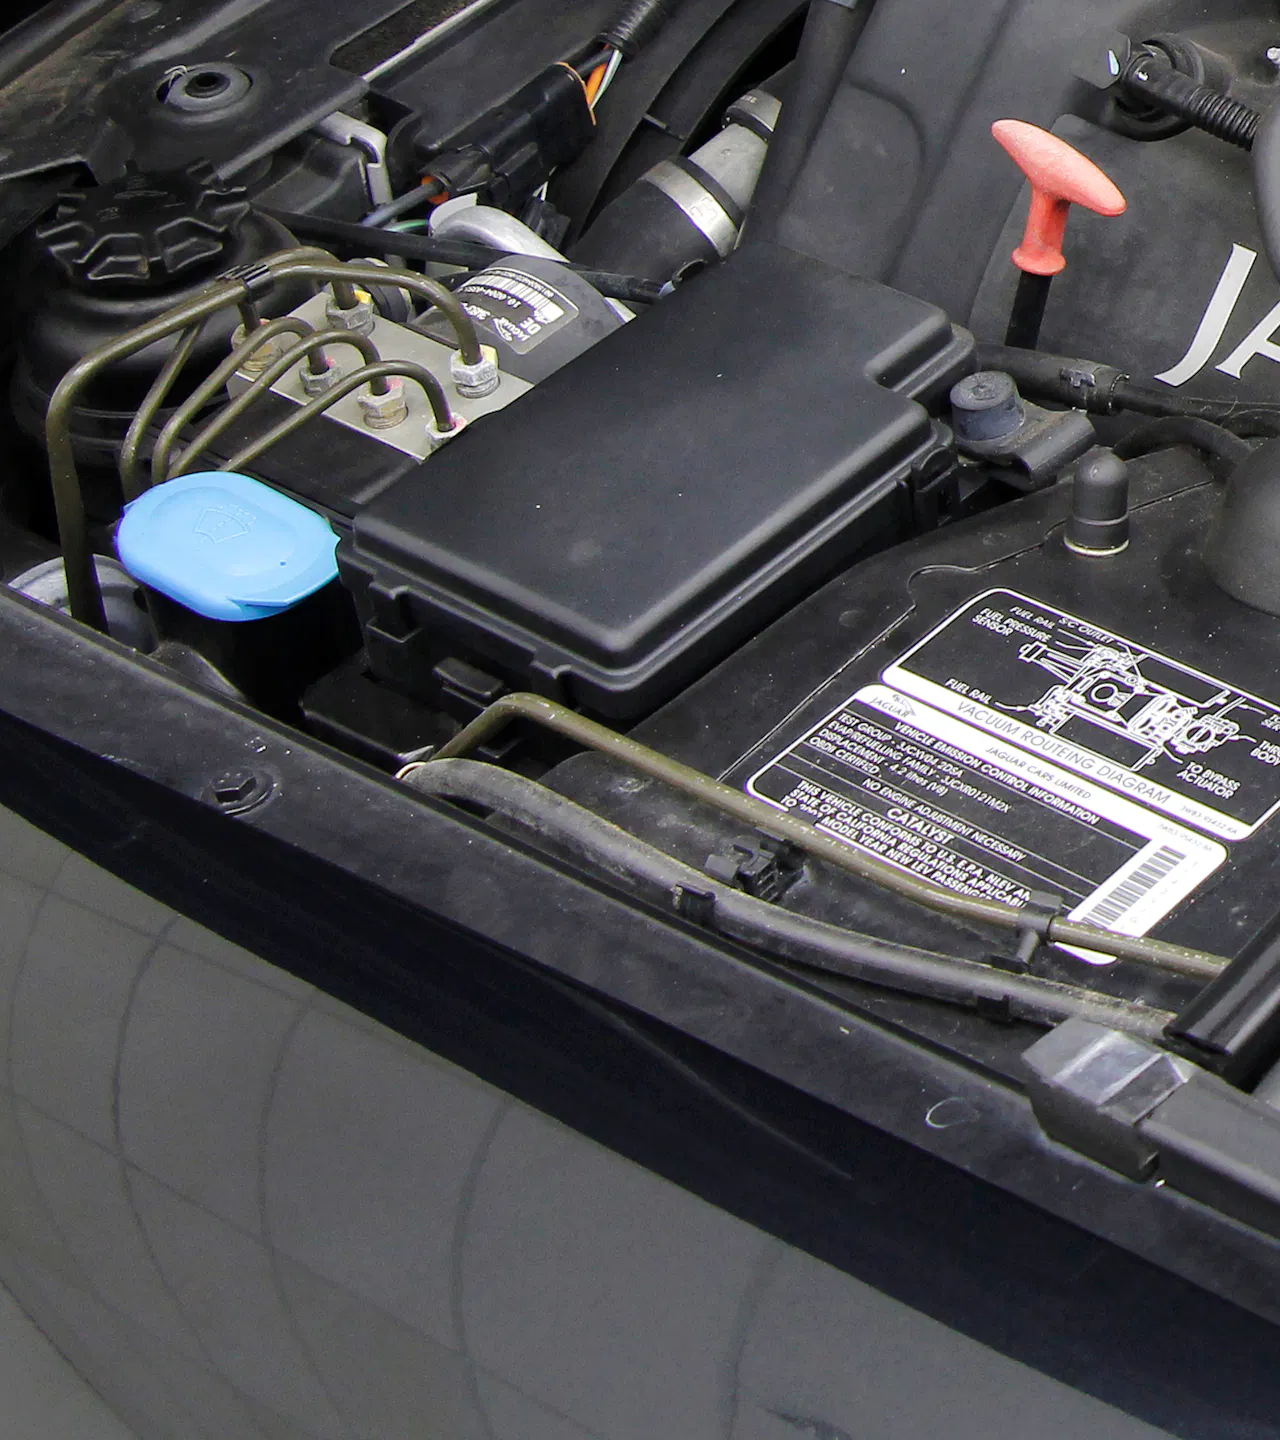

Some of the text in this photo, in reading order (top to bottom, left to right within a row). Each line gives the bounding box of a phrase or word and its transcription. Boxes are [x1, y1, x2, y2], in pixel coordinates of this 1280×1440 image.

[518, 316, 542, 335] DE
[972, 614, 1014, 637] SENSOR
[980, 607, 1052, 643] FUEL PRESSURE
[1009, 606, 1056, 630] FUEL RAIL
[1078, 625, 1115, 644] OUTLET
[869, 697, 912, 719] JAGUAR
[945, 678, 994, 705] FUEL RAIL
[837, 713, 859, 727] TEST
[857, 722, 893, 742] GROUP
[818, 728, 886, 764] DISPLACEMENT
[889, 763, 904, 776] 4.2
[905, 771, 928, 787] litres
[926, 781, 949, 797] (V8)
[903, 755, 936, 777] FAMILY
[957, 701, 1171, 804] VACUUM ROUTEING DIAGRAM
[894, 721, 1101, 826] VEHICLE EMISSION CONTROL INFORMATION
[986, 746, 1092, 799] JAGUAR CARS LIMITED
[1176, 770, 1235, 800] ACTUATOR
[1185, 762, 1241, 791] TO BYPASS
[780, 795, 798, 808] TO
[821, 816, 859, 839] MODEL
[858, 834, 889, 853] YEAR
[885, 848, 914, 865] NEW
[910, 860, 935, 875] LEV
[790, 789, 820, 807] STATE
[819, 804, 836, 816] OF
[835, 810, 899, 847] CALIFORNIA
[897, 843, 969, 882] REGULATIONS
[861, 778, 1027, 862] NO ENGINE ADJUSTMENT NECESSARY
[887, 808, 955, 847] CATALYST
[796, 780, 1031, 902] THIS VEHICLE CONFORMS TO U.S. E.P.A. NLEV AN
